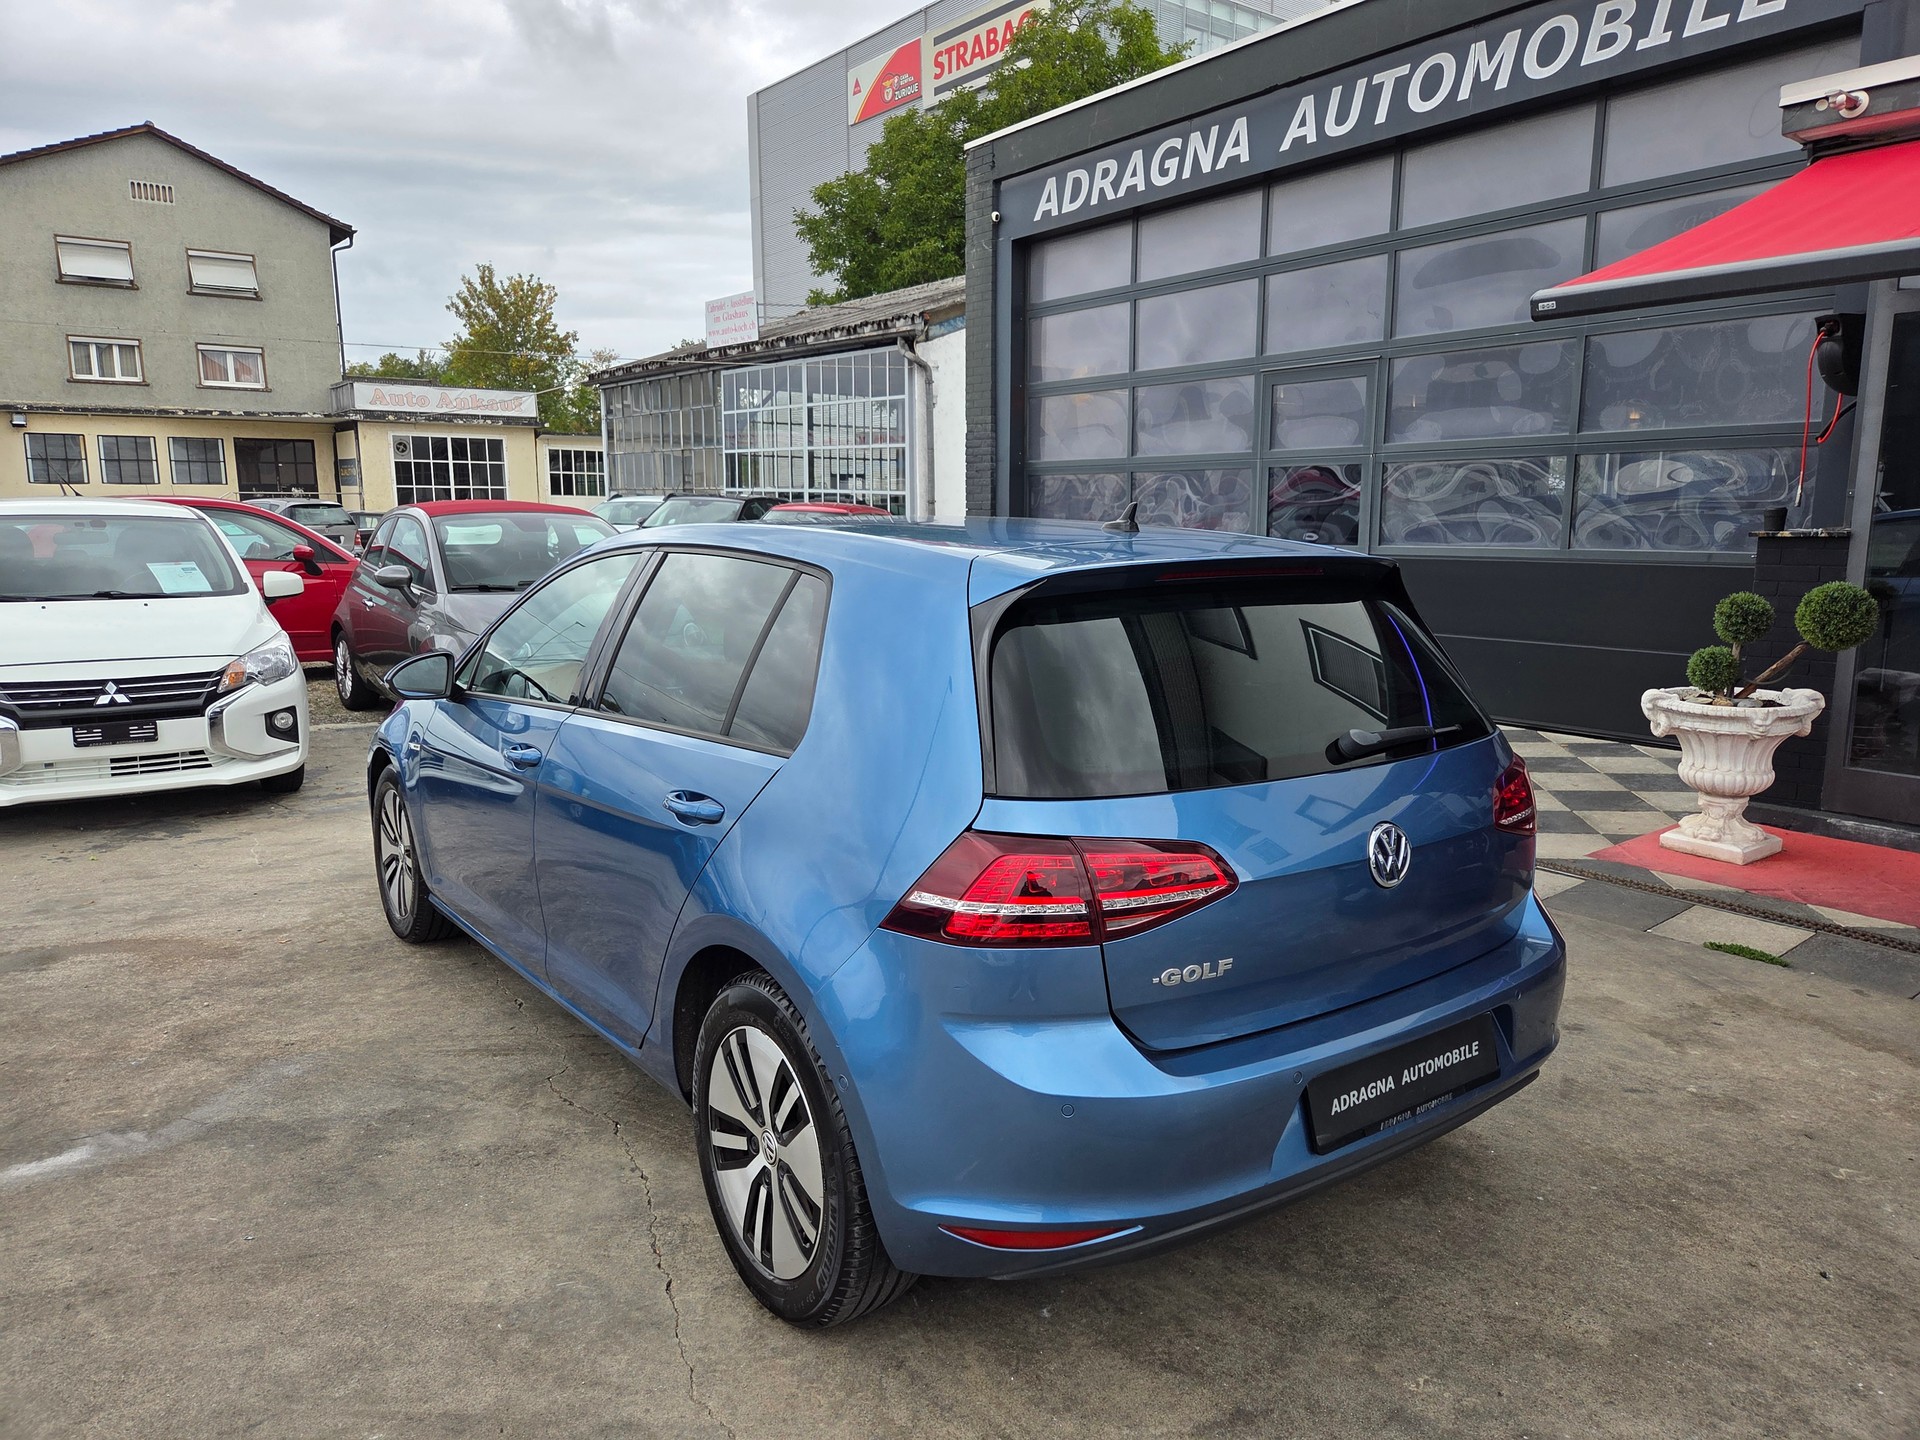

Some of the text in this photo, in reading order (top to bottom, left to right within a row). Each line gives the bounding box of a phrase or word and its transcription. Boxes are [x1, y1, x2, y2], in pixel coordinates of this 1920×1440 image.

[1033, 116, 1250, 221] ADRAGNA
[708, 320, 756, 337] www.auto-koch.ch
[713, 309, 748, 323] im Glashaus
[369, 388, 524, 413] Auto Ankauf
[1331, 1041, 1479, 1116] ADRAGNA AUTOMOBILE
